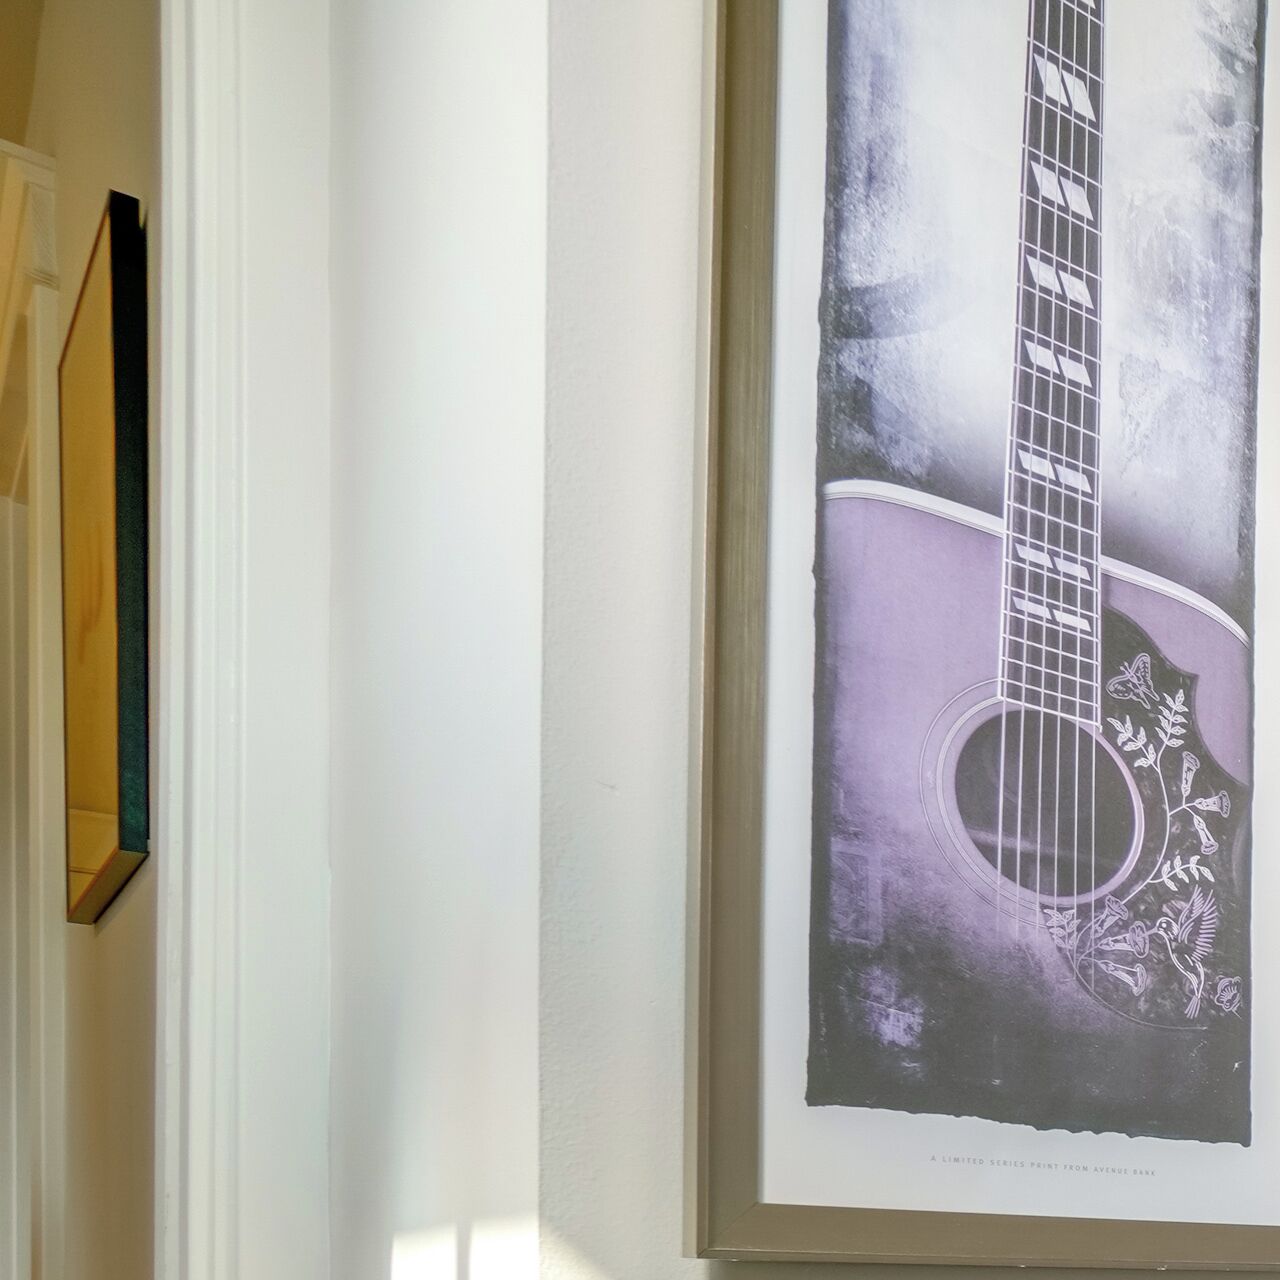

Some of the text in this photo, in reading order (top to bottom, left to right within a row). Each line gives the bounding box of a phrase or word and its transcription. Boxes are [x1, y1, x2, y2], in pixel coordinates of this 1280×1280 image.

[942, 1156, 984, 1165] LIMITED
[990, 1160, 1025, 1168] SERIES
[1030, 1162, 1058, 1170] PRINT
[1064, 1164, 1088, 1172] FROM
[1094, 1166, 1128, 1174] AVENUE
